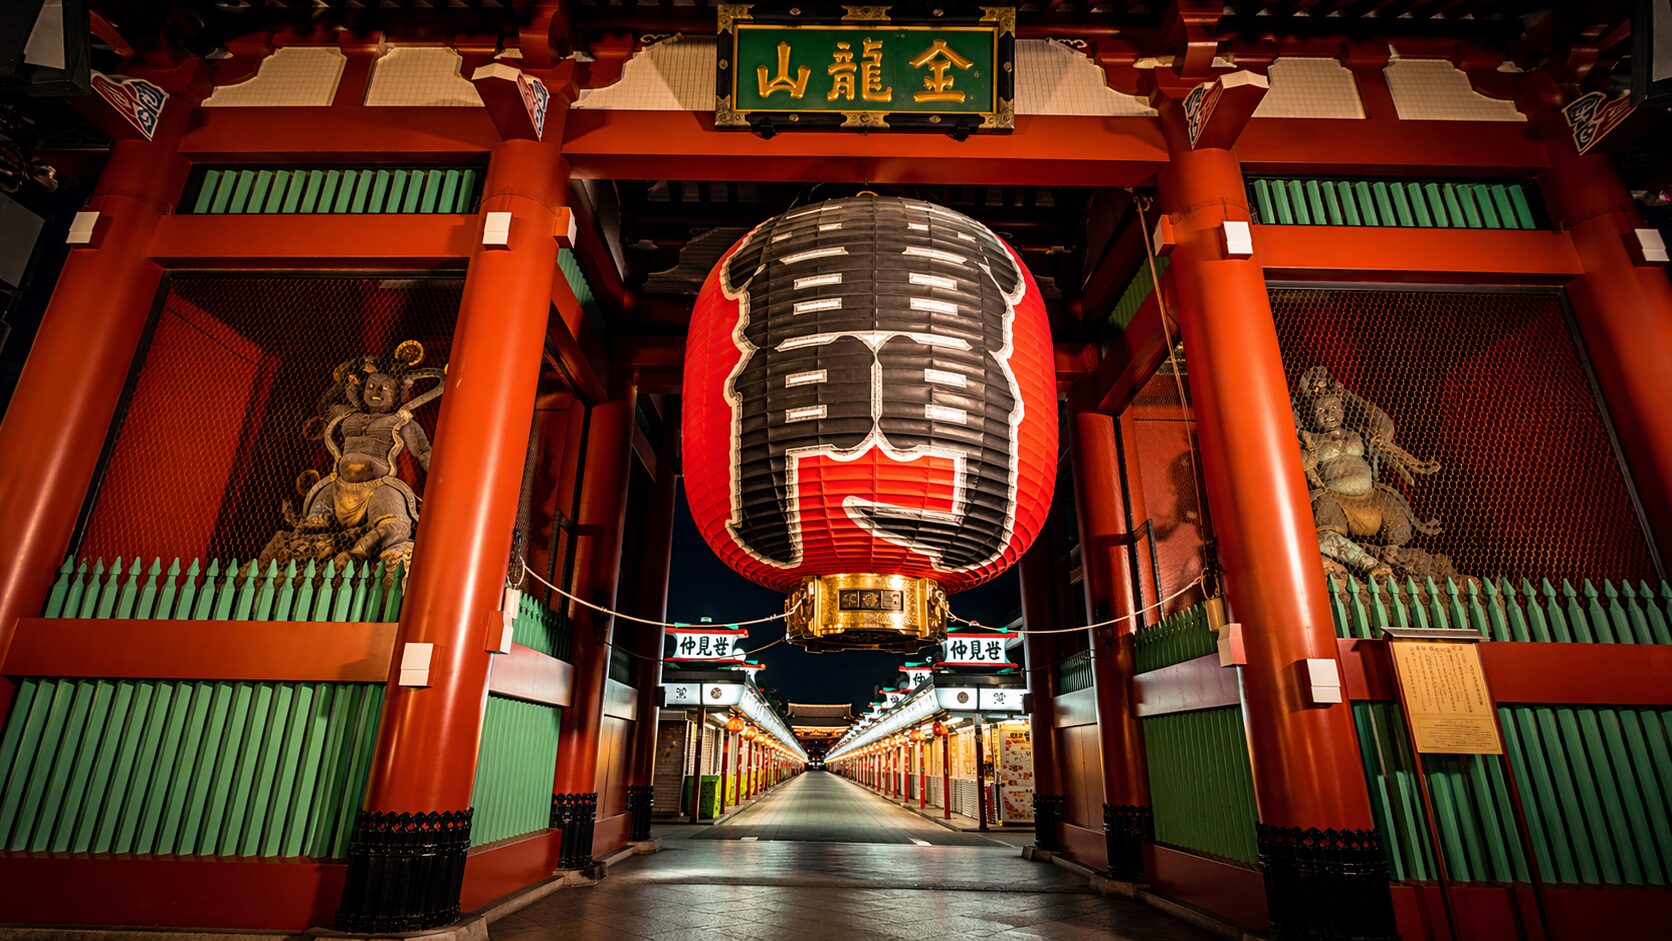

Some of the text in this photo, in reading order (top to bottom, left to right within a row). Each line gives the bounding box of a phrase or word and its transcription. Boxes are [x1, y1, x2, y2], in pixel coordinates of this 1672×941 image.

[757, 38, 974, 103] 金龍山
[680, 636, 729, 656] 仲見世
[950, 640, 1002, 660] 仲見世
